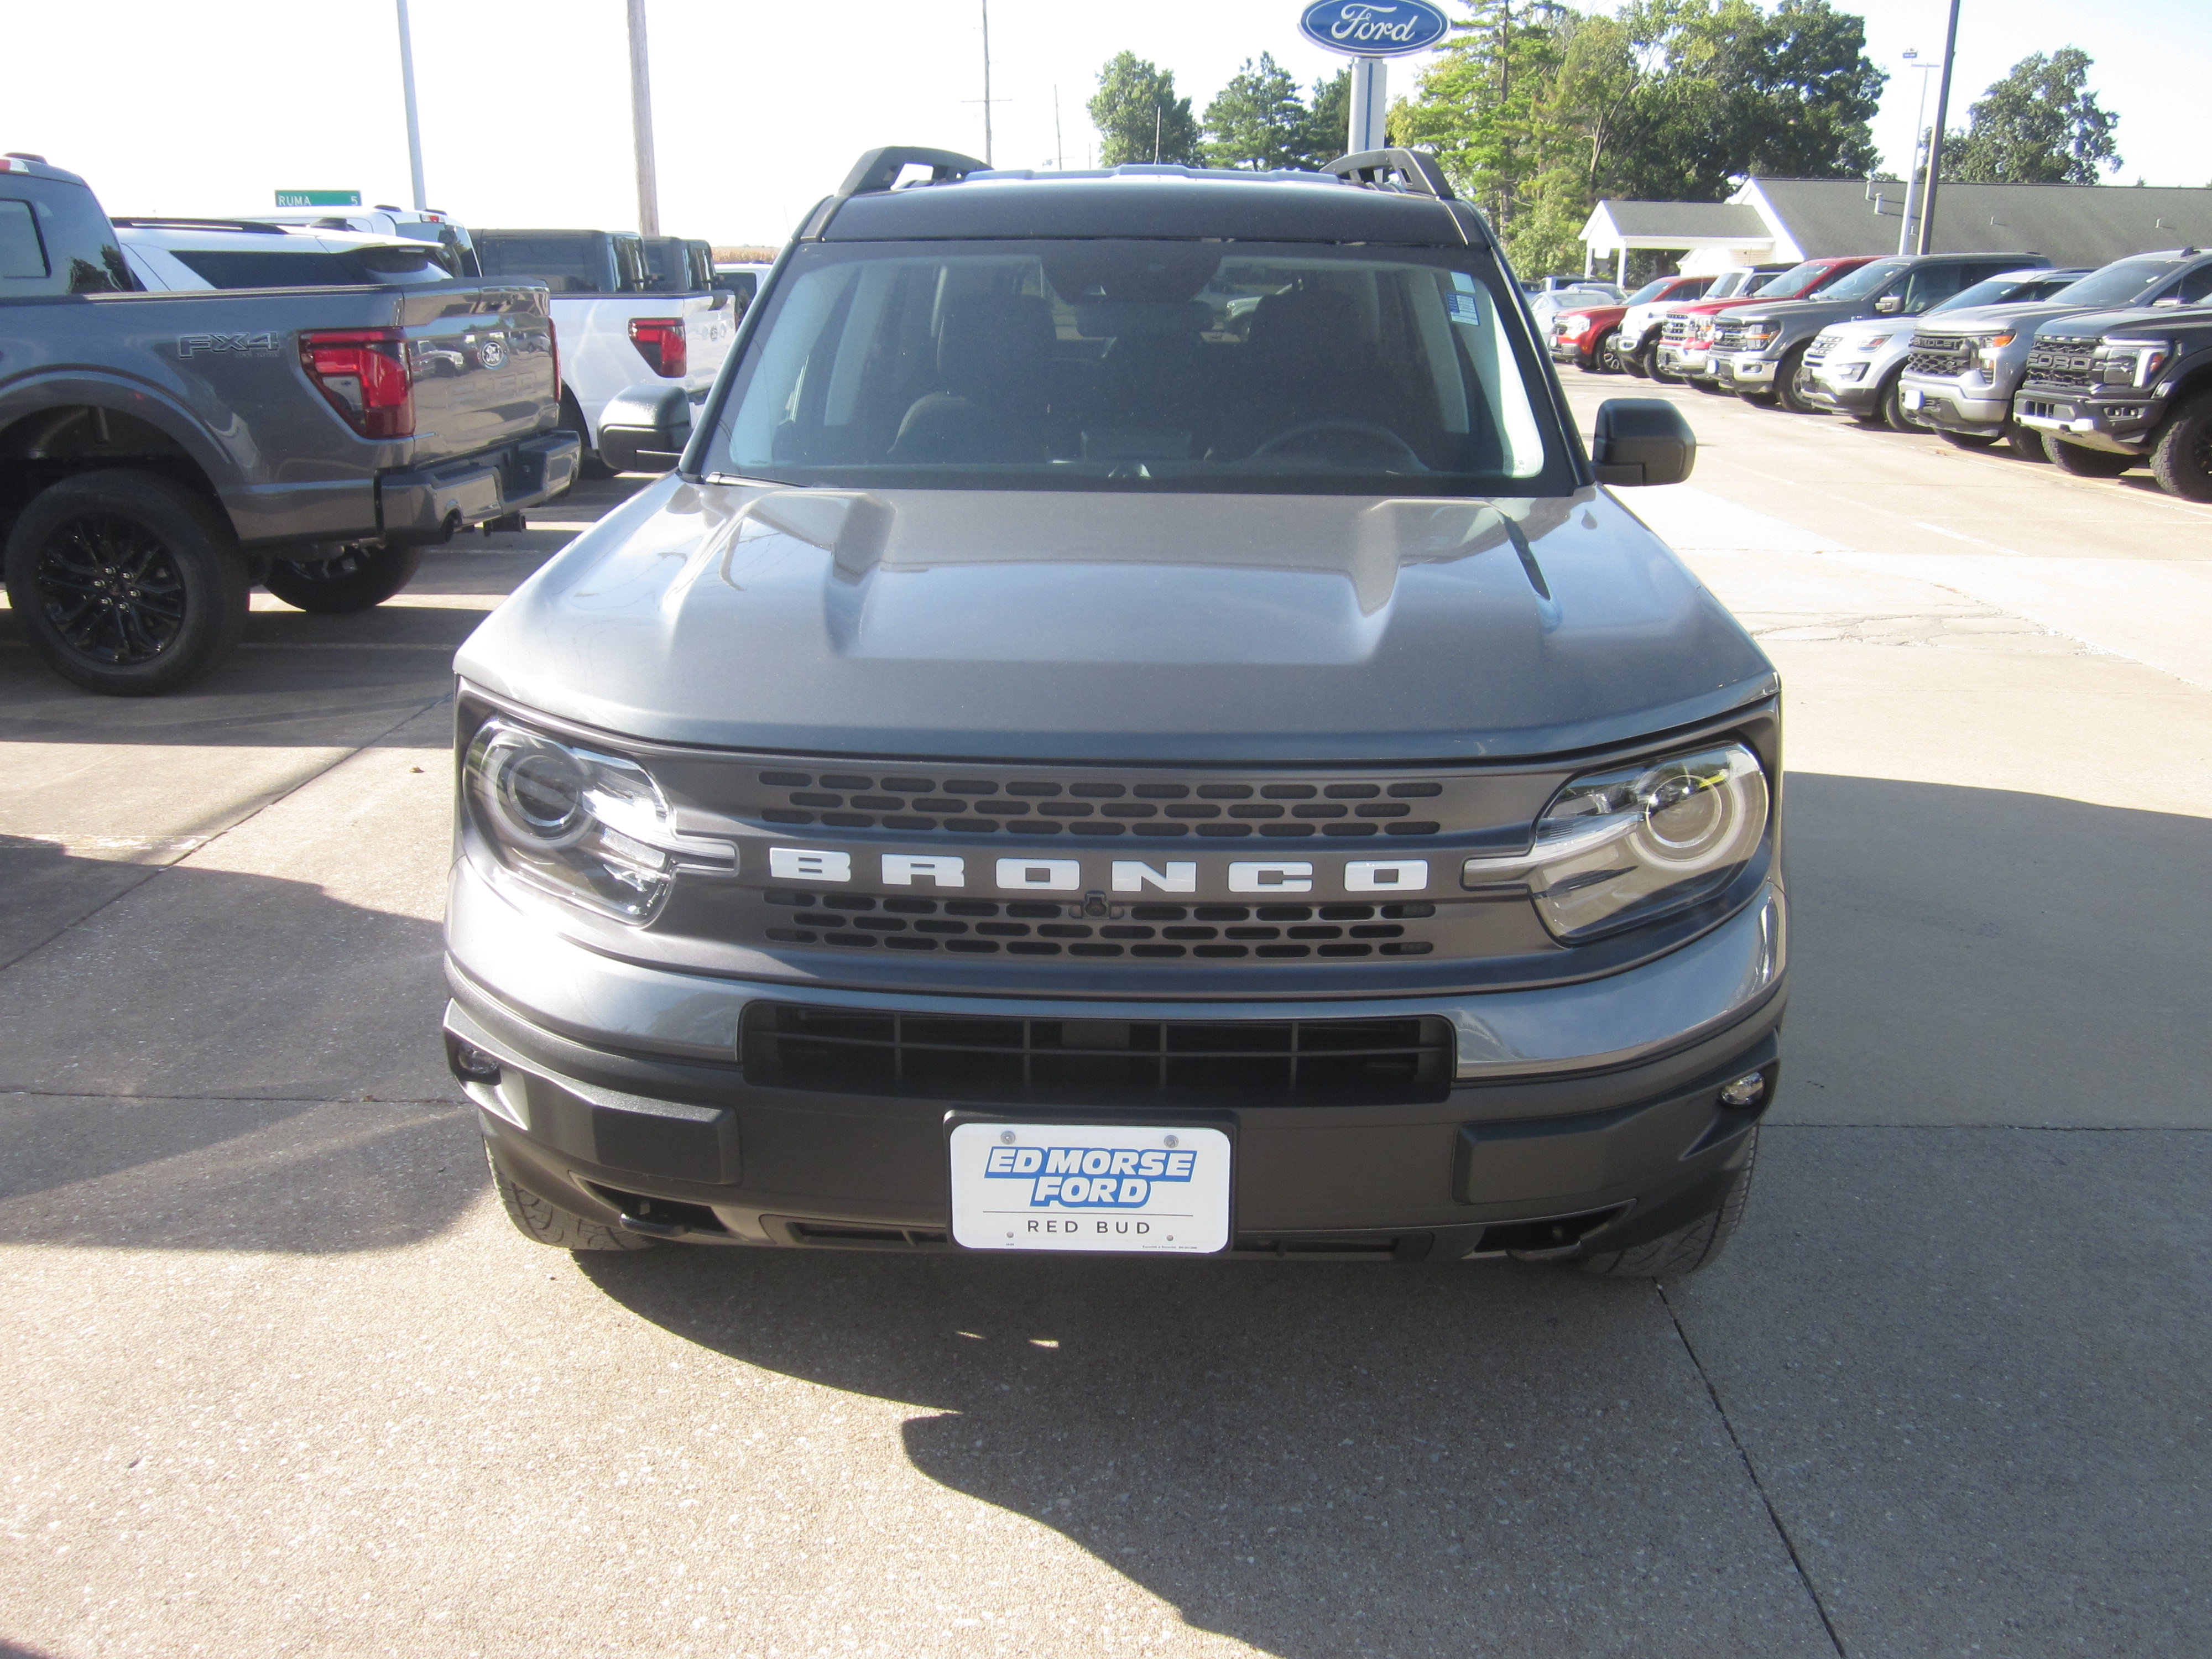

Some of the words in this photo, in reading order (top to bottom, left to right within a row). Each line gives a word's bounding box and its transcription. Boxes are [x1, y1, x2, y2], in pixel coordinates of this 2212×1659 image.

[1331, 3, 1419, 41] Ford
[278, 196, 312, 206] RUMA
[350, 196, 358, 206] 5
[179, 332, 279, 359] FX4
[2027, 352, 2091, 371] FORD
[769, 847, 1428, 892] BRONCO
[988, 1148, 1043, 1173] ED
[1045, 1149, 1195, 1177] MORSE
[1034, 1176, 1149, 1204] FORD
[1027, 1220, 1079, 1233] RED
[1097, 1221, 1150, 1234] BUD
